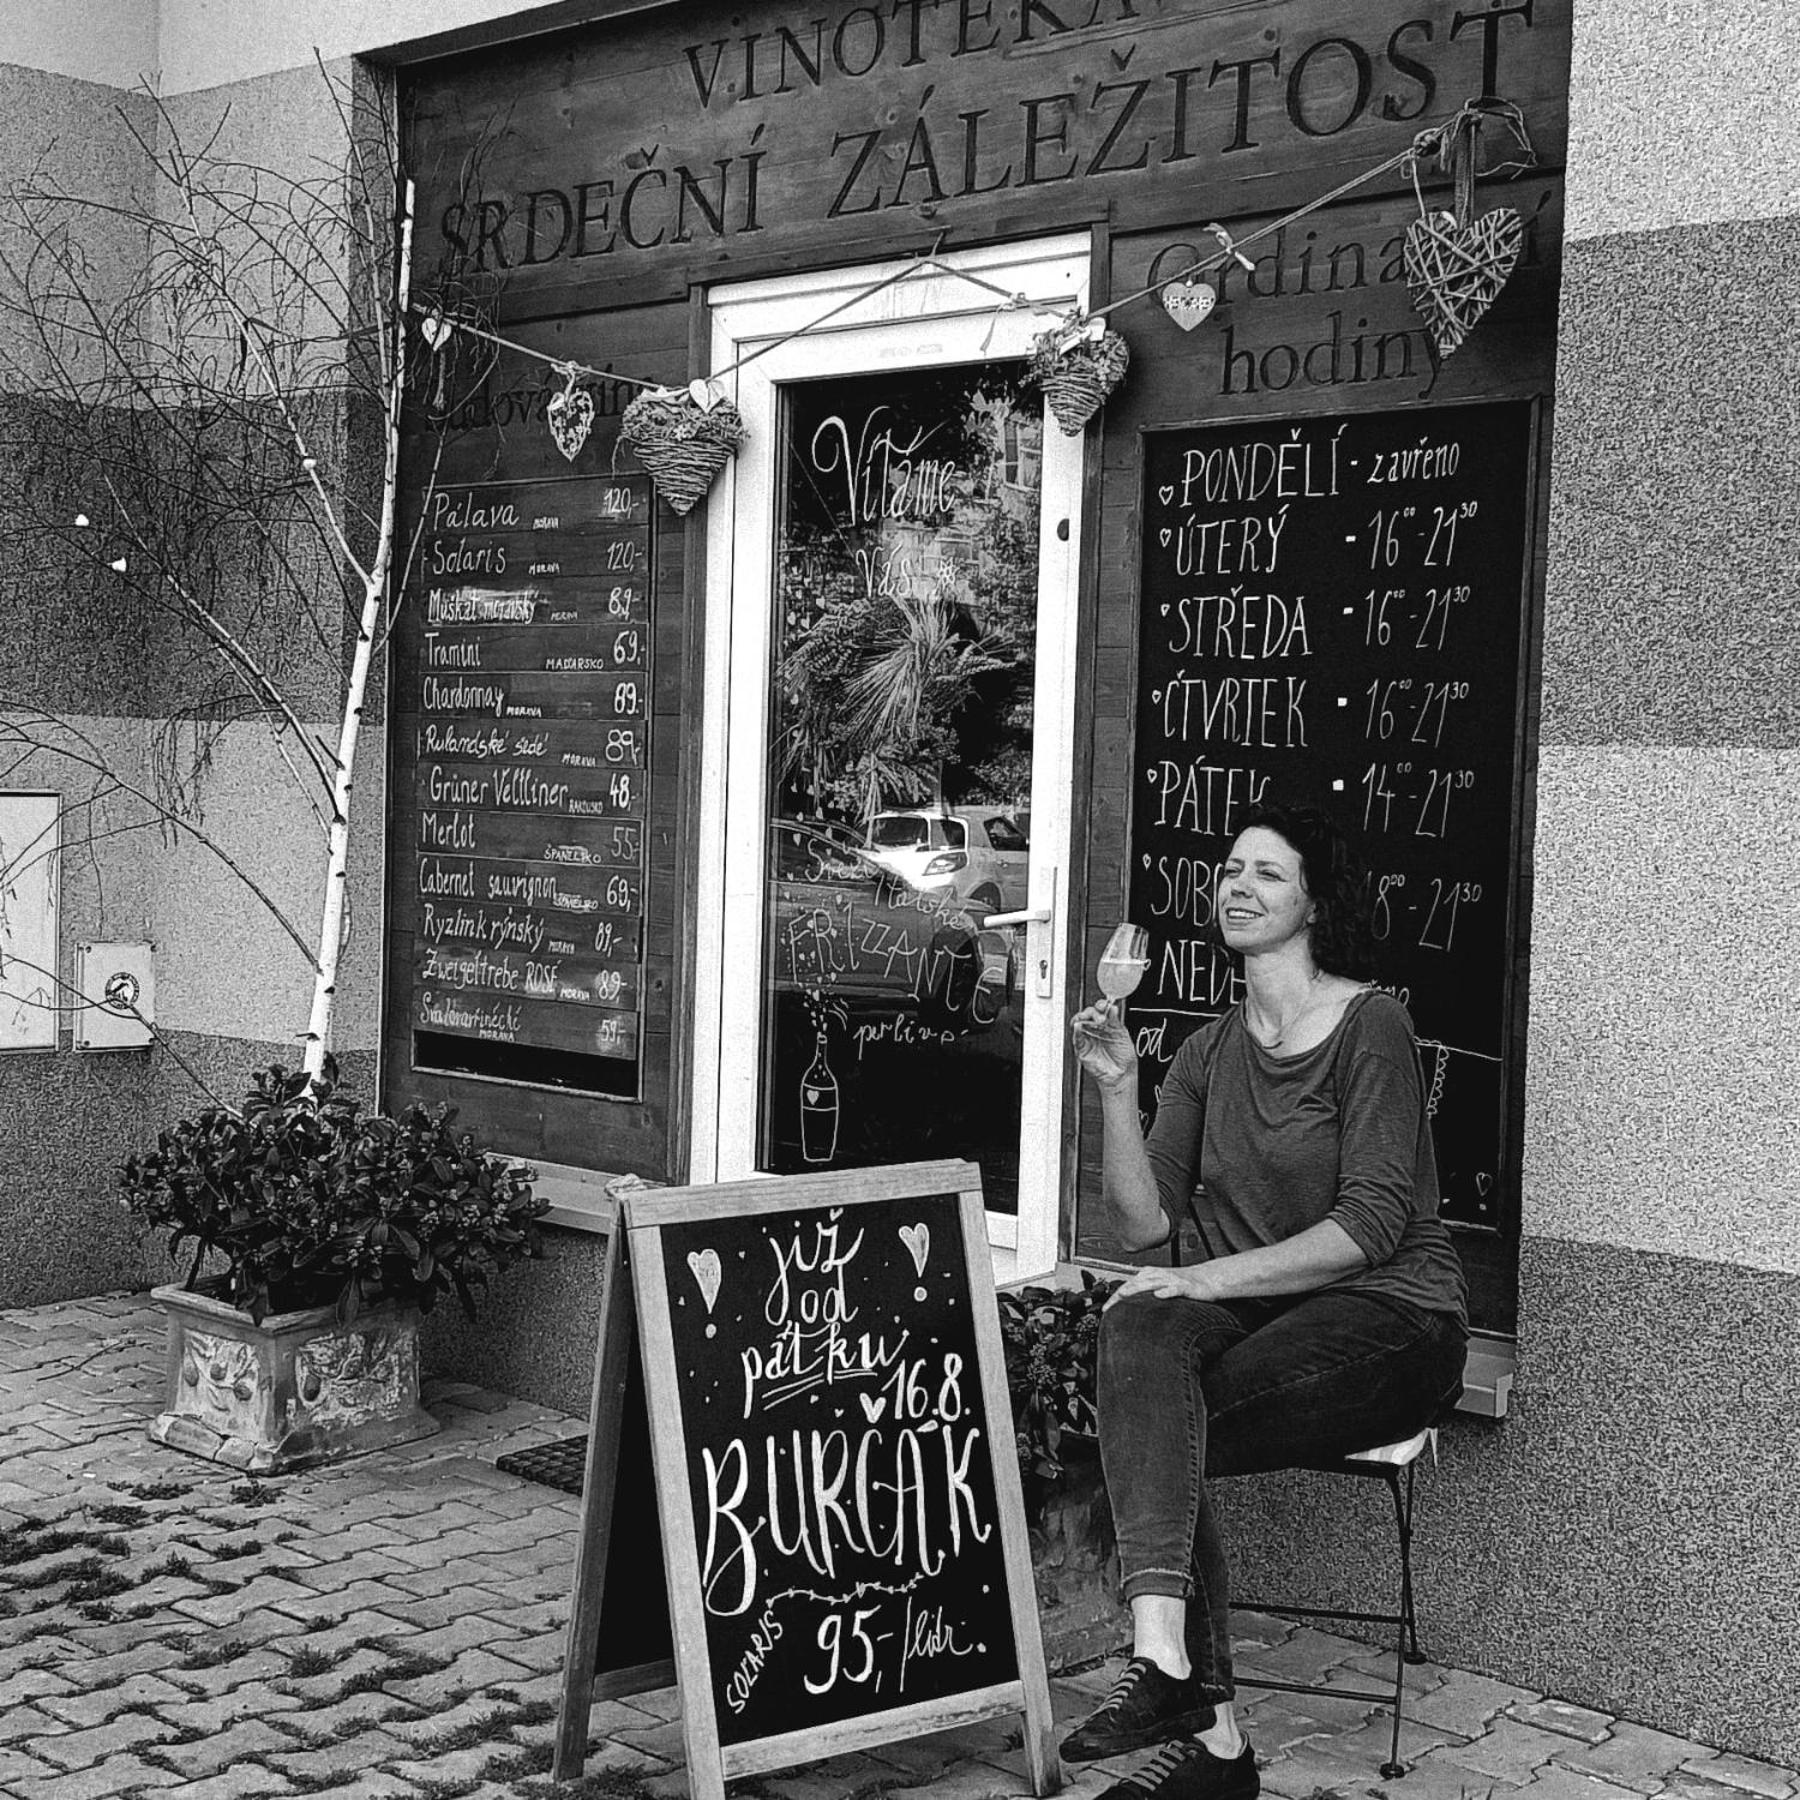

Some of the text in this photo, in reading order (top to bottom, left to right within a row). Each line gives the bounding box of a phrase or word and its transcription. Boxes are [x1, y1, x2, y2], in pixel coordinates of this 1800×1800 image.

[684, 0, 1141, 108] VINOTEK
[441, 0, 1534, 274] SRDEČNÍ ZÁLEŽITOST
[1148, 191, 1552, 305] Ordinaí
[1222, 310, 1441, 399] hodiny
[812, 406, 956, 526] Vítáme
[1180, 423, 1349, 507] PONDĚLÍ
[1366, 436, 1460, 484] zavřeno
[434, 491, 519, 531] Pálava
[1176, 503, 1291, 576] ÚTERÝ
[432, 537, 506, 575] Solaris
[855, 541, 912, 598] Vás
[1169, 584, 1313, 659] STŘEDA
[423, 676, 504, 717] Chardonnay
[506, 706, 542, 717] MORAVA
[1163, 670, 1308, 748] ČTVRTEK
[425, 724, 509, 759] Rulandské
[561, 753, 596, 767] MORAVA
[430, 765, 488, 804] Grüner
[492, 767, 568, 807] Veltliner
[422, 812, 476, 849] Merlot
[419, 857, 475, 897] Cabernet
[488, 871, 557, 906] sauvignon
[606, 875, 638, 912] 69,-
[1150, 855, 1222, 928] SOB
[424, 903, 487, 944] Ryzlink
[489, 907, 545, 953] rýnský
[788, 901, 1003, 1024] FRIZZANTE
[422, 948, 519, 991] Zweigeltrebe
[559, 988, 590, 1001] MORAVA
[479, 1029, 515, 1042] MORAVA
[1136, 1017, 1174, 1063] od
[765, 1208, 864, 1326] již
[801, 1265, 858, 1323] od
[741, 1320, 910, 1419] pátku
[726, 1610, 783, 1714] SOLARIS
